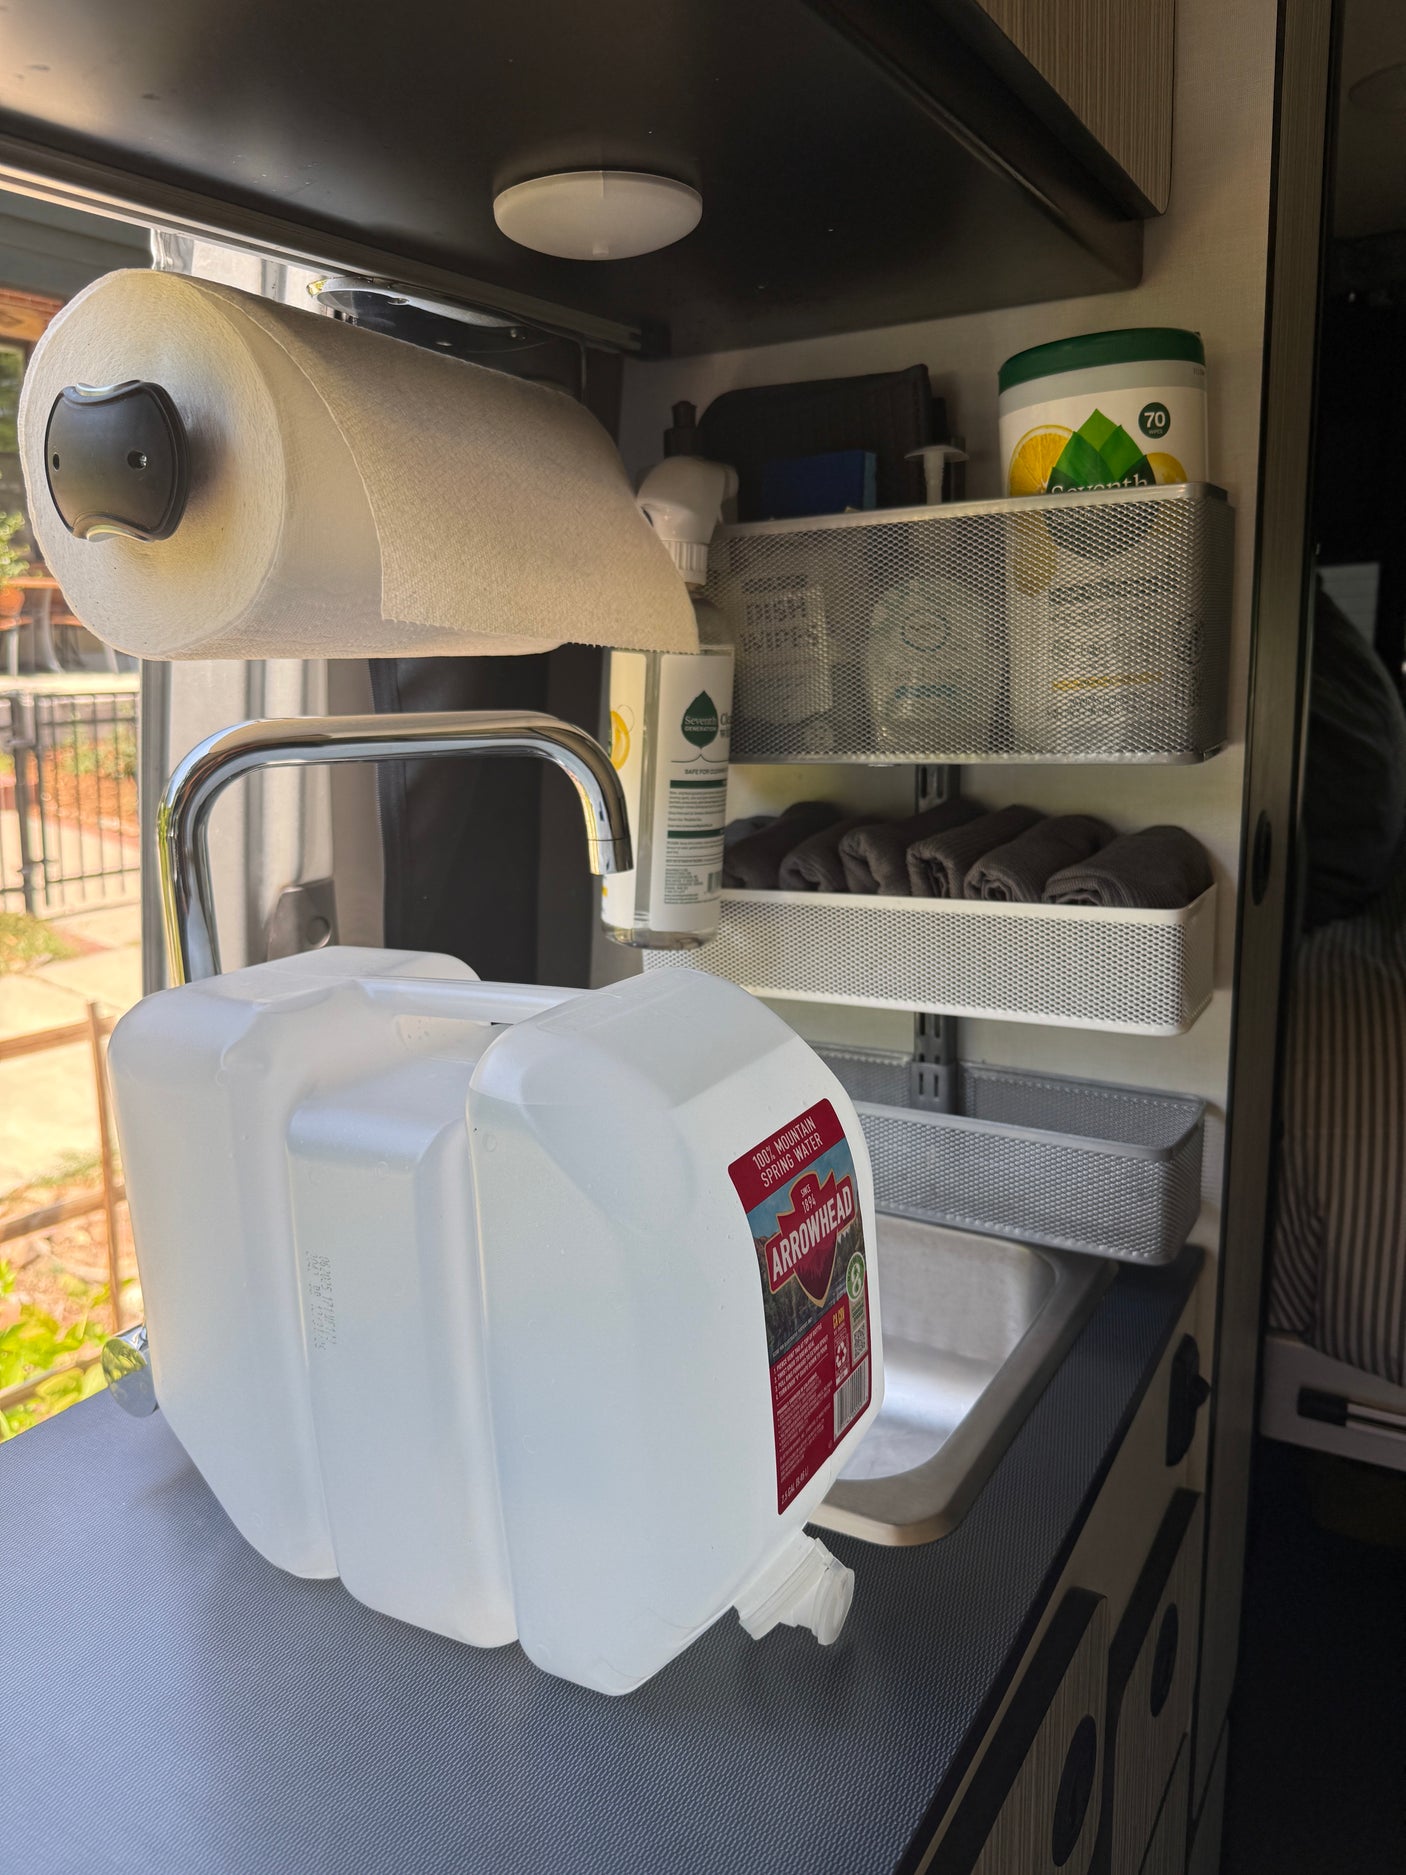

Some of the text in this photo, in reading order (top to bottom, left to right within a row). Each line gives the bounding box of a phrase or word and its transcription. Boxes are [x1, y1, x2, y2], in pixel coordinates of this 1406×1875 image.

[1144, 411, 1166, 428] 70
[752, 1116, 816, 1171] 100% MOUNTAIN
[760, 1131, 824, 1188] SPRING WATER
[800, 1184, 811, 1196] SINCE
[801, 1197, 816, 1213] 1894
[771, 1185, 853, 1283] ARROWHEAD
